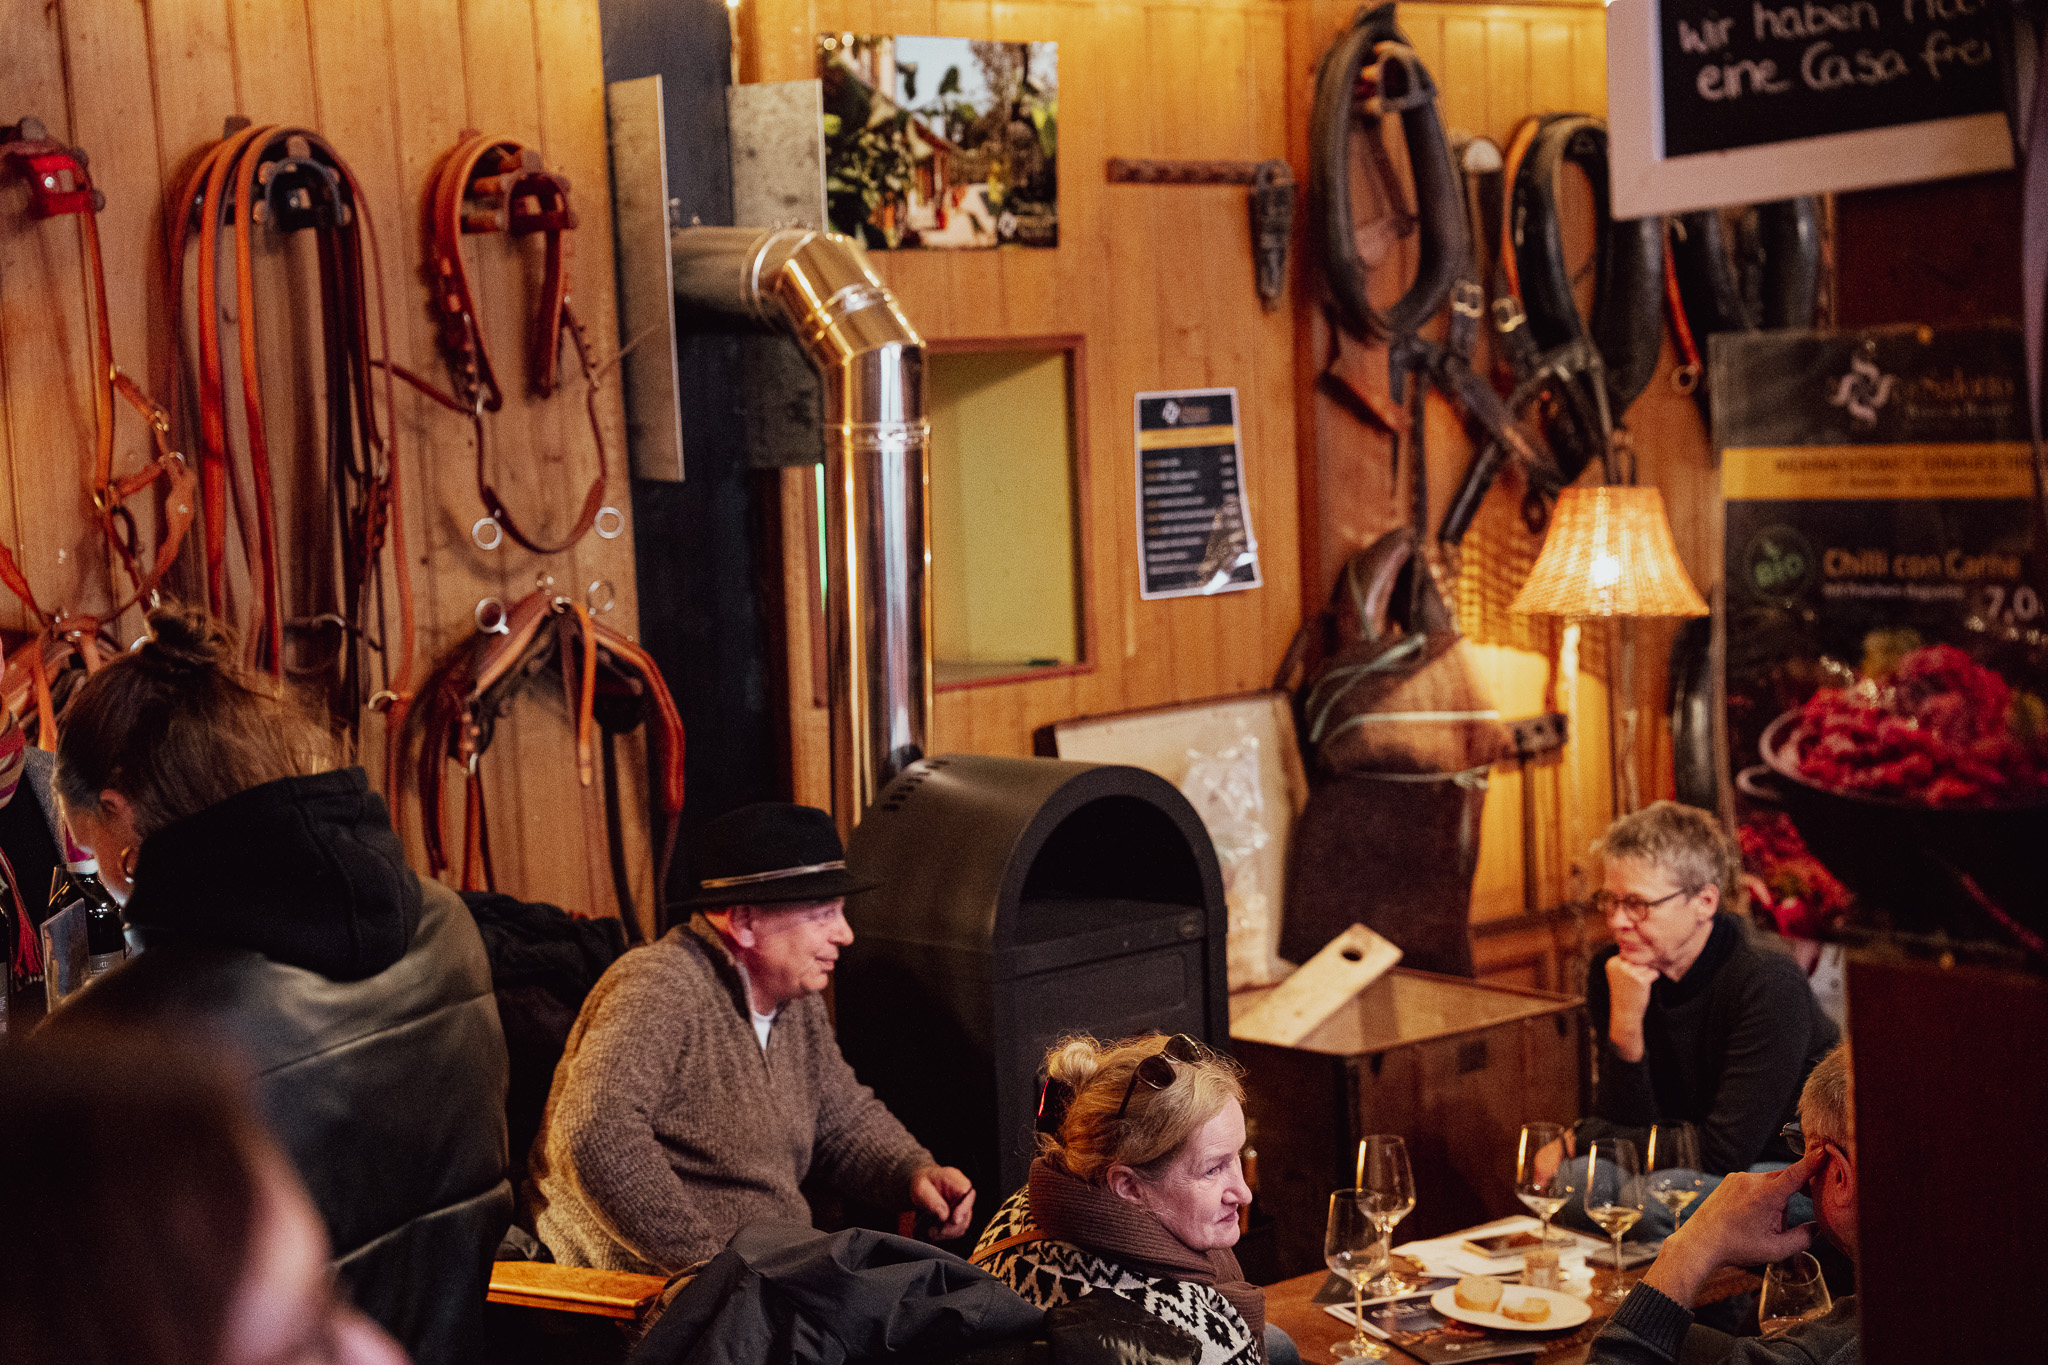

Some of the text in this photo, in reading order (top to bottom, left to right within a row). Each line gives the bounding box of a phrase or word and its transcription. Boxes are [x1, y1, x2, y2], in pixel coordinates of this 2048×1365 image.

[1752, 0, 1881, 41] haben
[1695, 51, 1793, 101] eine
[1800, 40, 1909, 91] Casa
